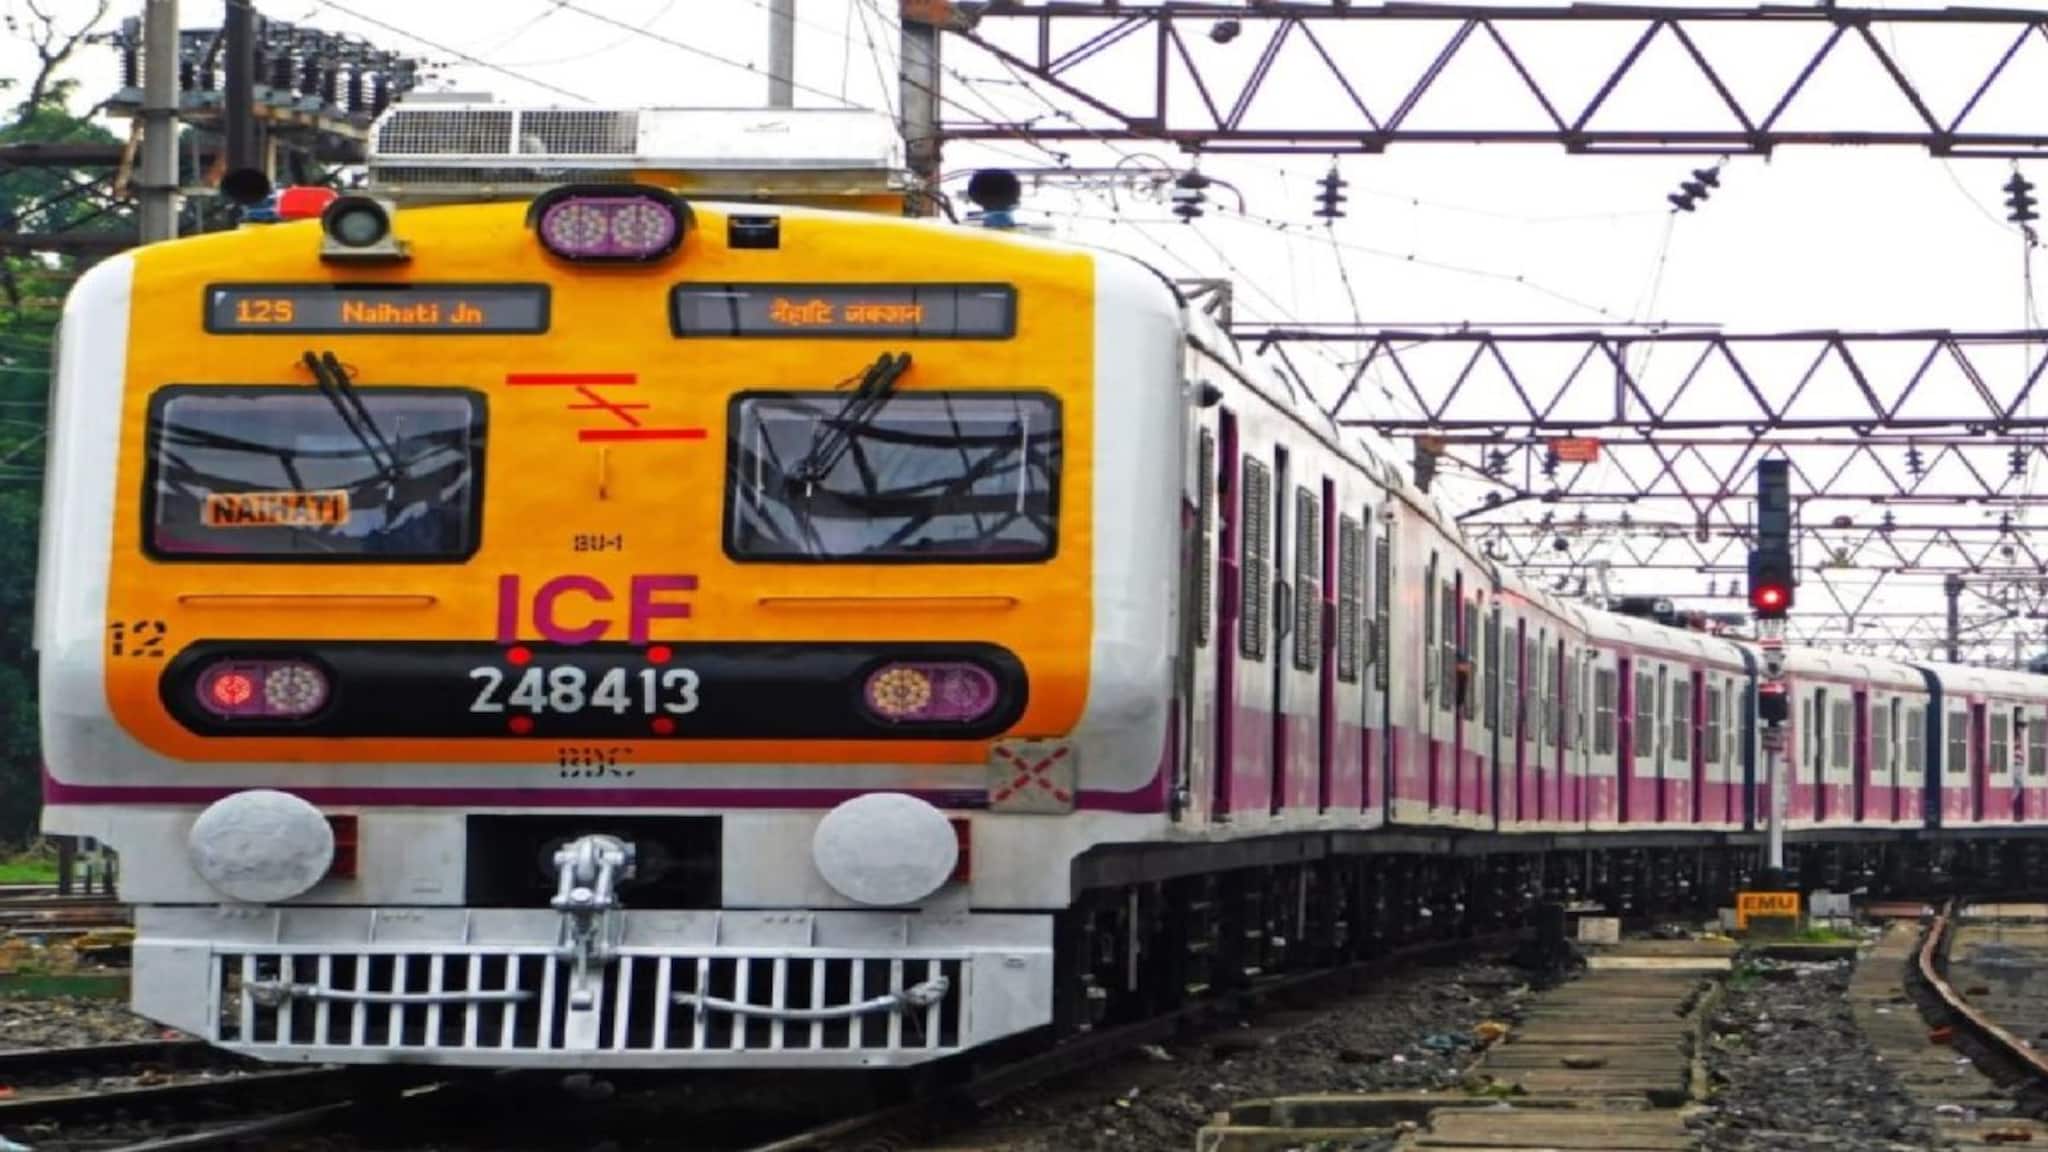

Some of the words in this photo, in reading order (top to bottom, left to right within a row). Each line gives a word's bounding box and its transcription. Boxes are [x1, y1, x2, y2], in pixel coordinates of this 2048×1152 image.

[235, 298, 294, 323] 125
[341, 300, 439, 325] Naihati
[450, 300, 483, 325] Jn
[212, 494, 342, 524] NAIHATI
[496, 574, 700, 646] ICF
[109, 620, 166, 657] 12
[468, 665, 700, 715] 248413
[1743, 895, 1795, 910] EMU
